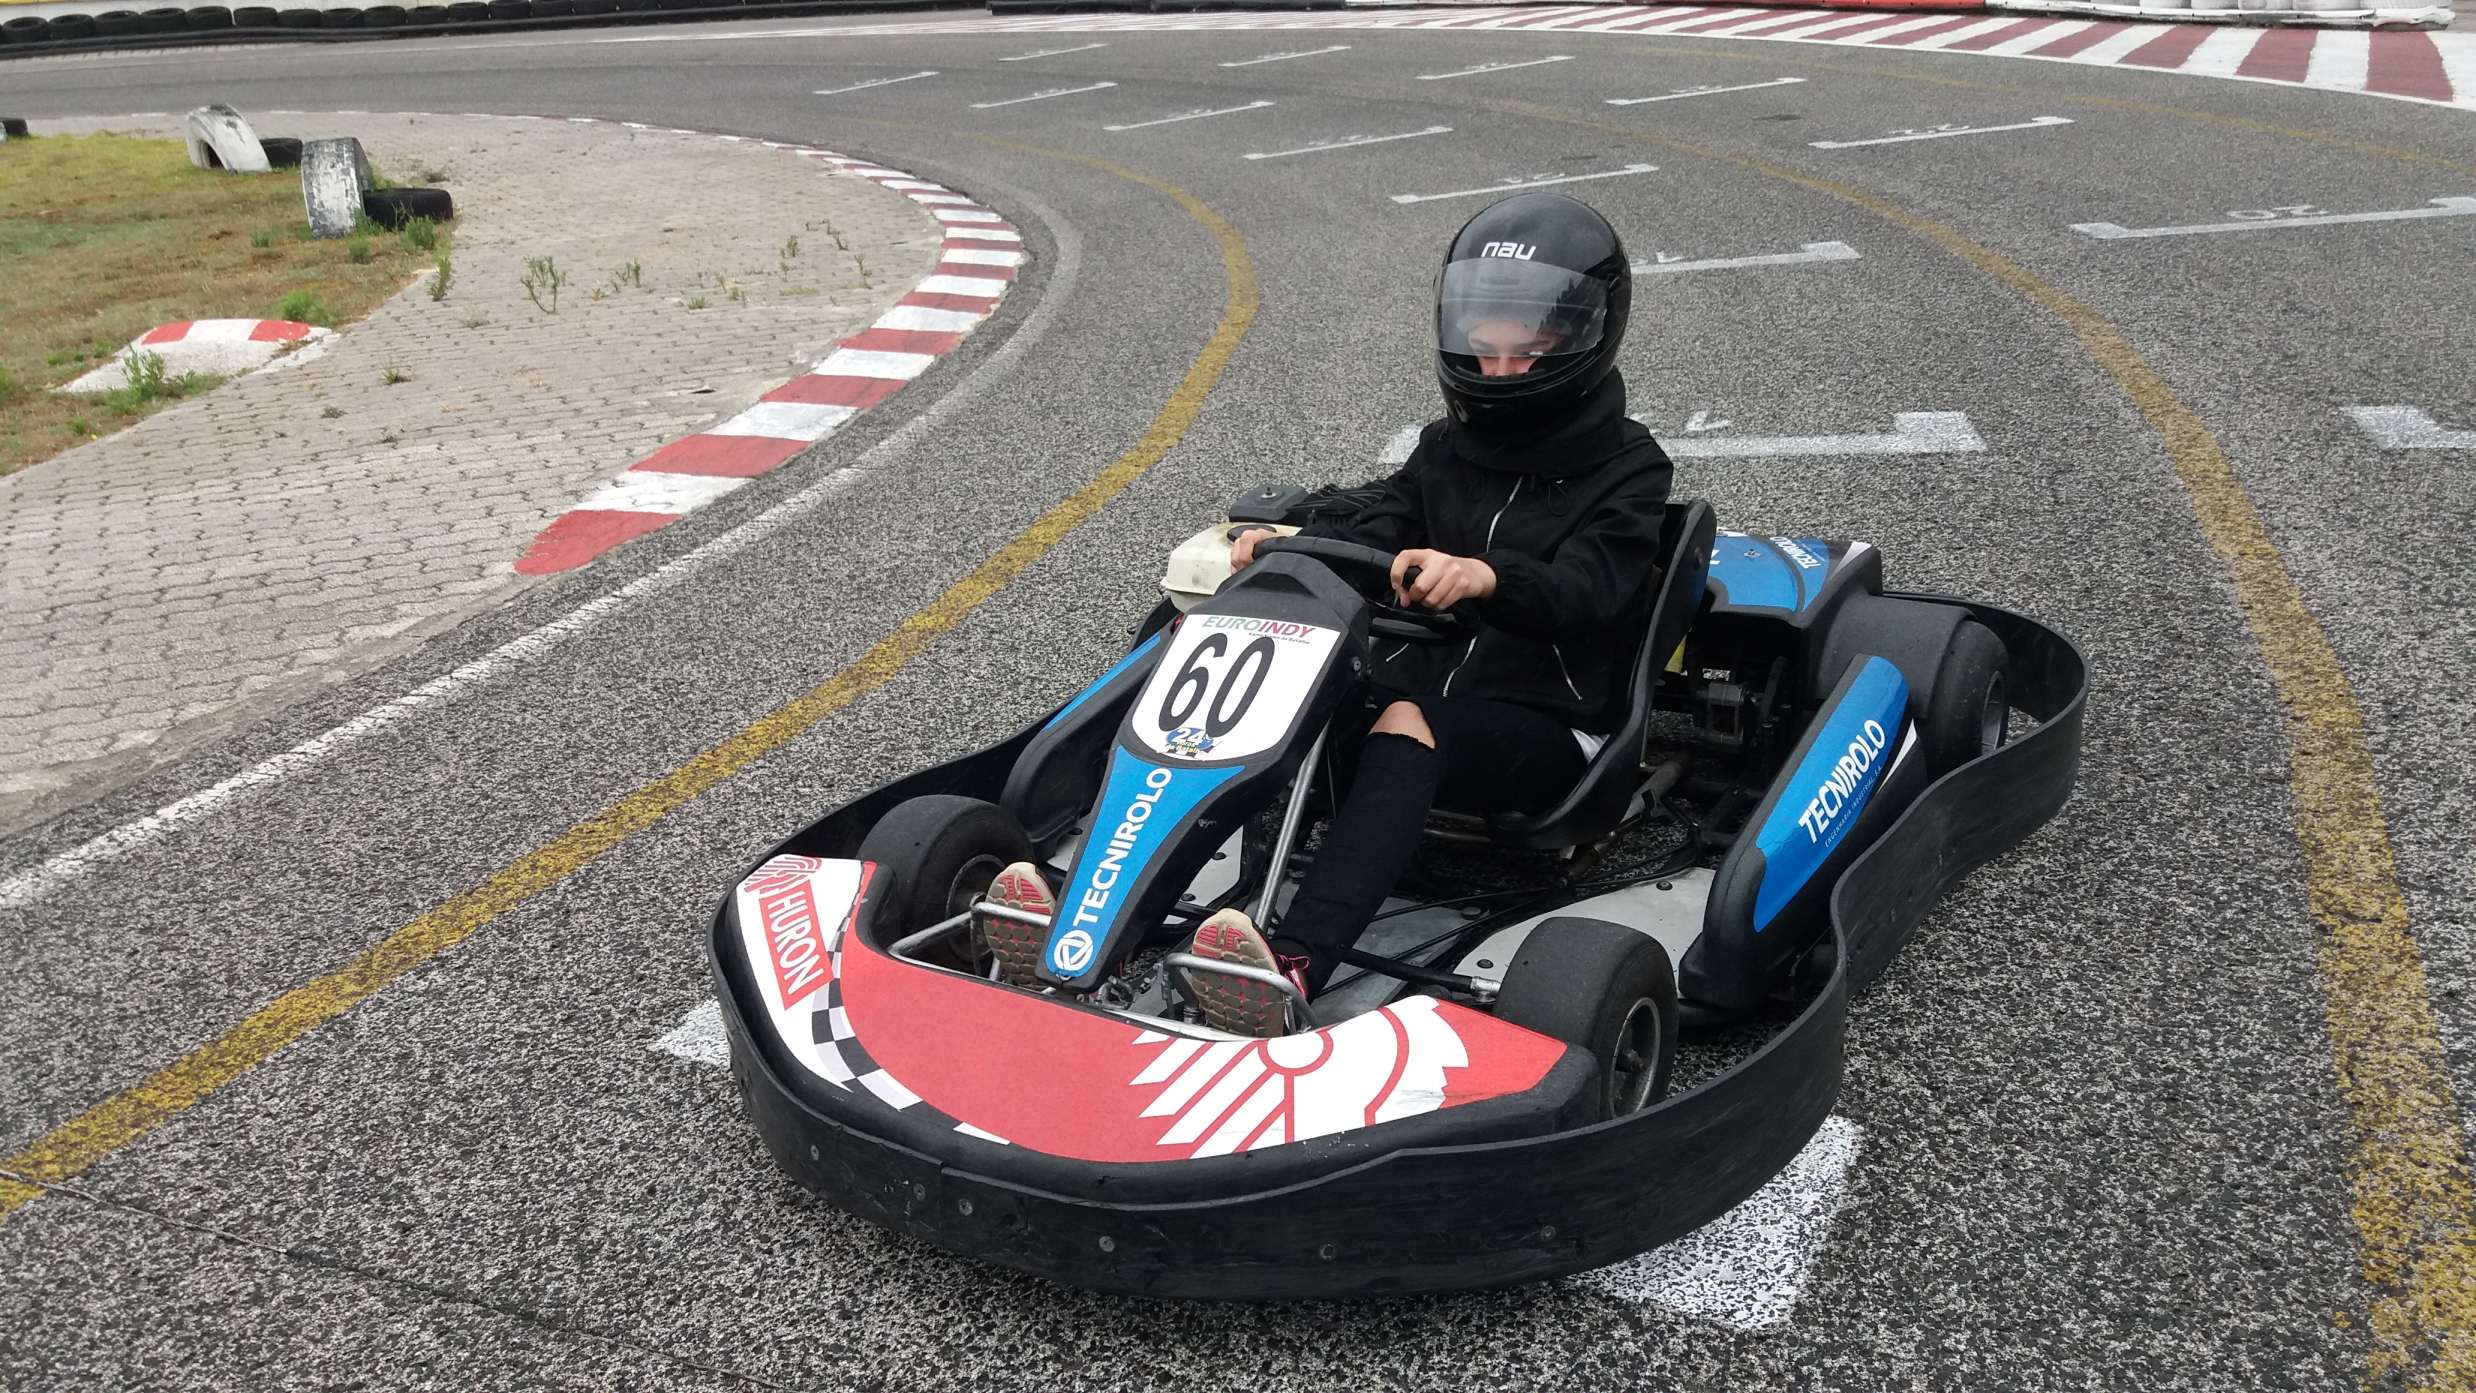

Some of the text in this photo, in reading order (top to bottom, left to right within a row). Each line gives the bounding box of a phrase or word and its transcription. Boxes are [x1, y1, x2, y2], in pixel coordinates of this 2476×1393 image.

[1481, 241, 1537, 261] nau
[1202, 616, 1316, 638] EUROINDY
[1157, 632, 1276, 738] 60
[1170, 726, 1206, 746] 24
[1797, 718, 1887, 844] TECNIROLO
[1073, 767, 1173, 928] TECNIROLO
[767, 889, 825, 996] HURON
